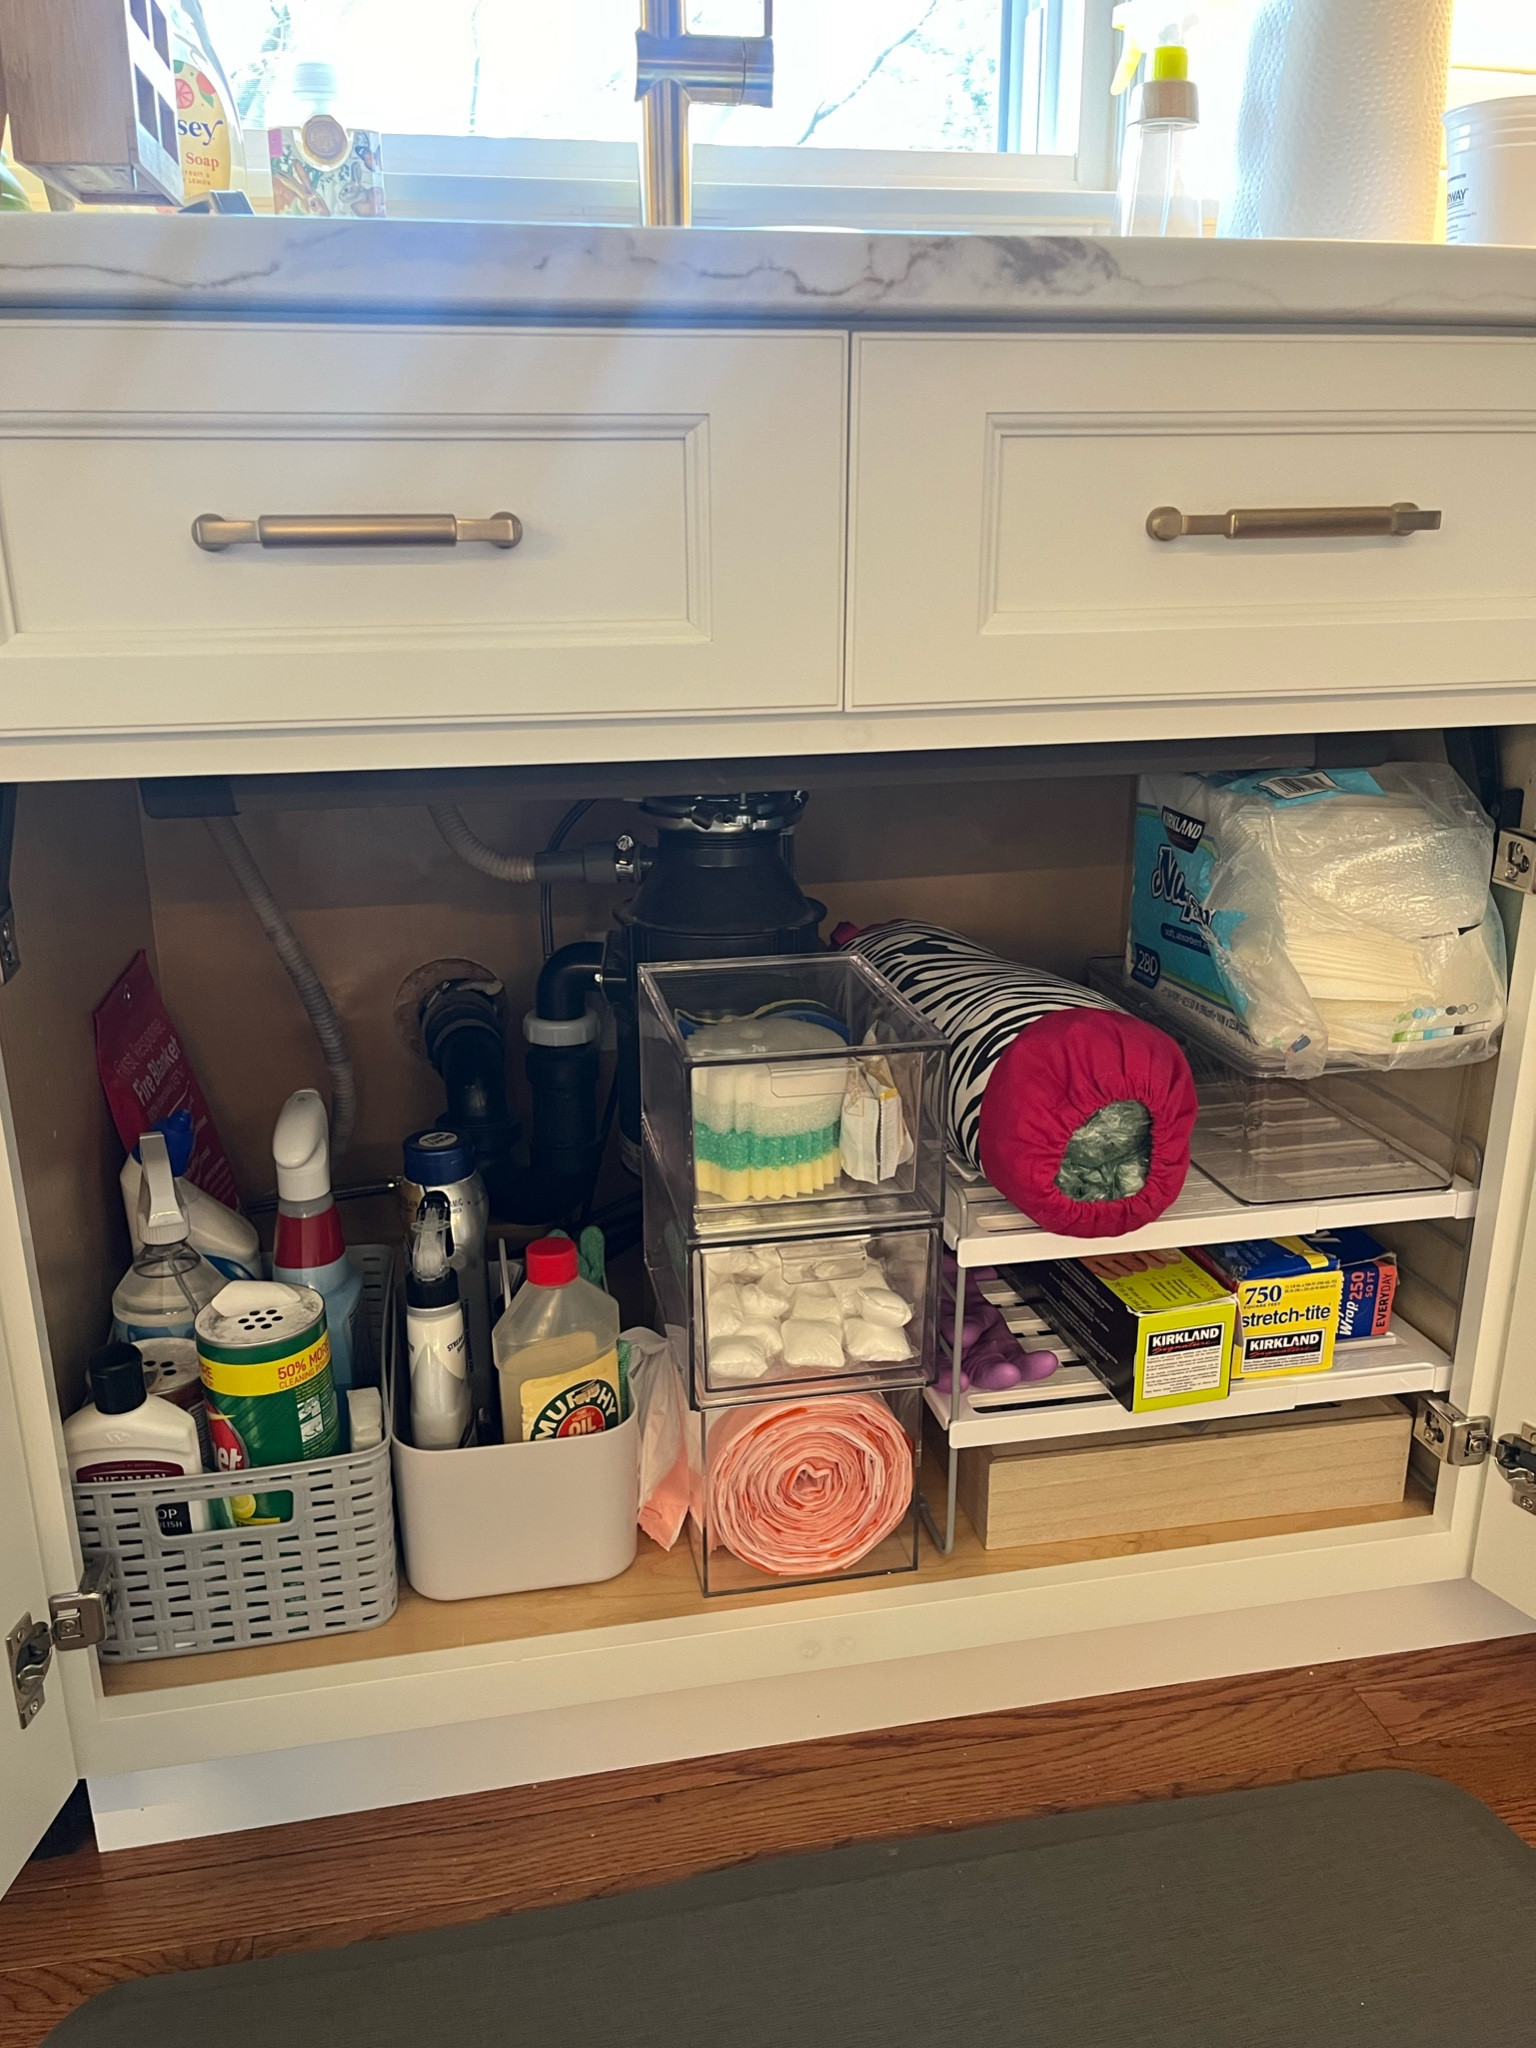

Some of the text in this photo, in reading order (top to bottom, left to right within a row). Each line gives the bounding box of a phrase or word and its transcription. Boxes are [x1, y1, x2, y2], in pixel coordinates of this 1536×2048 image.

[186, 152, 219, 172] Soap
[1162, 810, 1203, 841] KIRKLAND
[1136, 950, 1159, 977] 280
[132, 1075, 156, 1106] Fire
[149, 1034, 182, 1085] Blanket
[1244, 1284, 1282, 1305] 750
[1349, 1271, 1365, 1300] 250
[1365, 1271, 1376, 1298] SQ FT
[1376, 1273, 1393, 1328] EVERYDAY
[1242, 1304, 1331, 1328] stretch-tite
[1339, 1301, 1358, 1336] Wrap
[1152, 1327, 1220, 1347] KIRKLAND
[1249, 1333, 1320, 1351] KIRKLAND
[277, 1359, 307, 1380] 50%
[279, 1366, 315, 1390] CLEANING
[567, 1416, 598, 1436] OIL
[157, 1507, 178, 1520] OP
